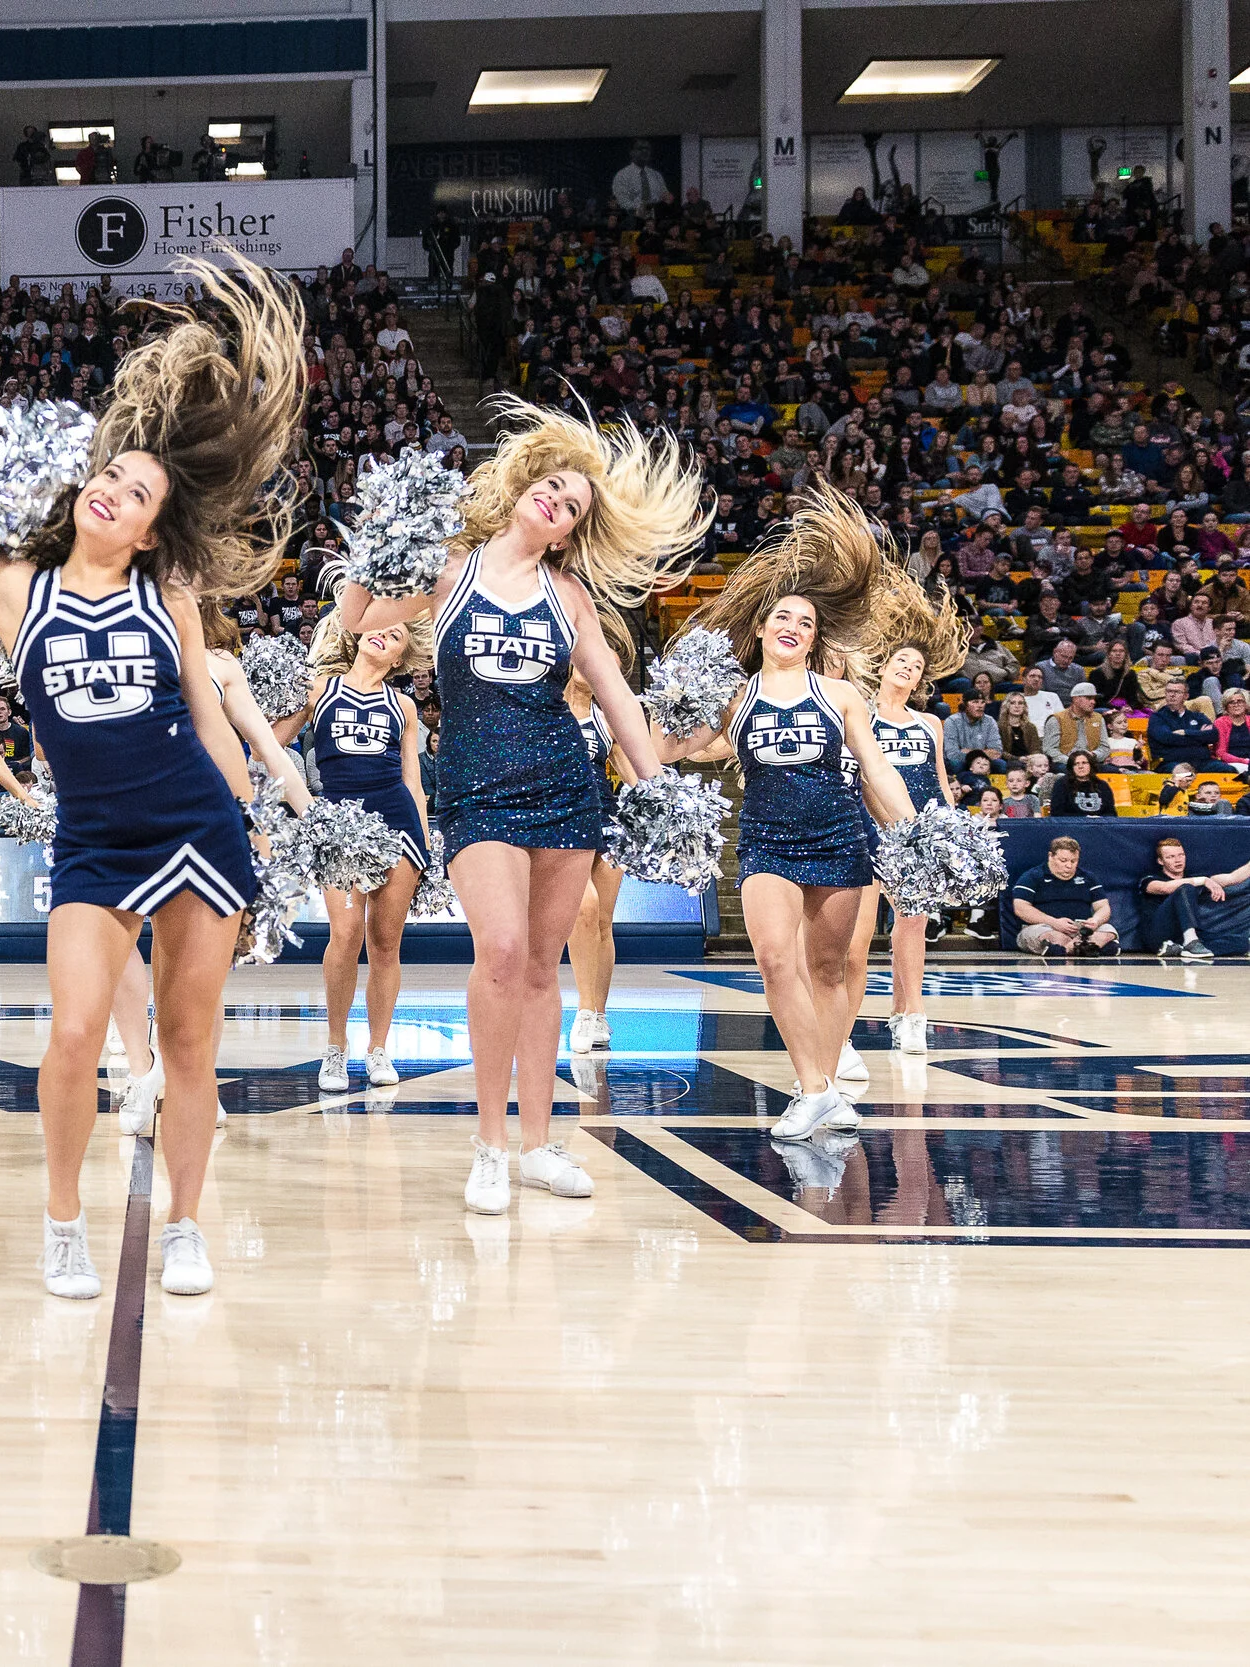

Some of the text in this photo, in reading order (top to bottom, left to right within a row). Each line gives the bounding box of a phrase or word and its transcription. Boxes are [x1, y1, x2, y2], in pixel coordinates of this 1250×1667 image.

[775, 137, 794, 155] M
[1205, 126, 1221, 145] N
[390, 150, 522, 181] AGGIES
[471, 186, 567, 217] CONSERVIC
[96, 212, 127, 252] F
[159, 201, 276, 239] Fisher
[154, 241, 197, 255] Home
[50, 281, 77, 291] Noh
[464, 633, 556, 666] STATE
[42, 658, 157, 697] STATE
[330, 721, 392, 744] STATE
[746, 727, 828, 751] STATE
